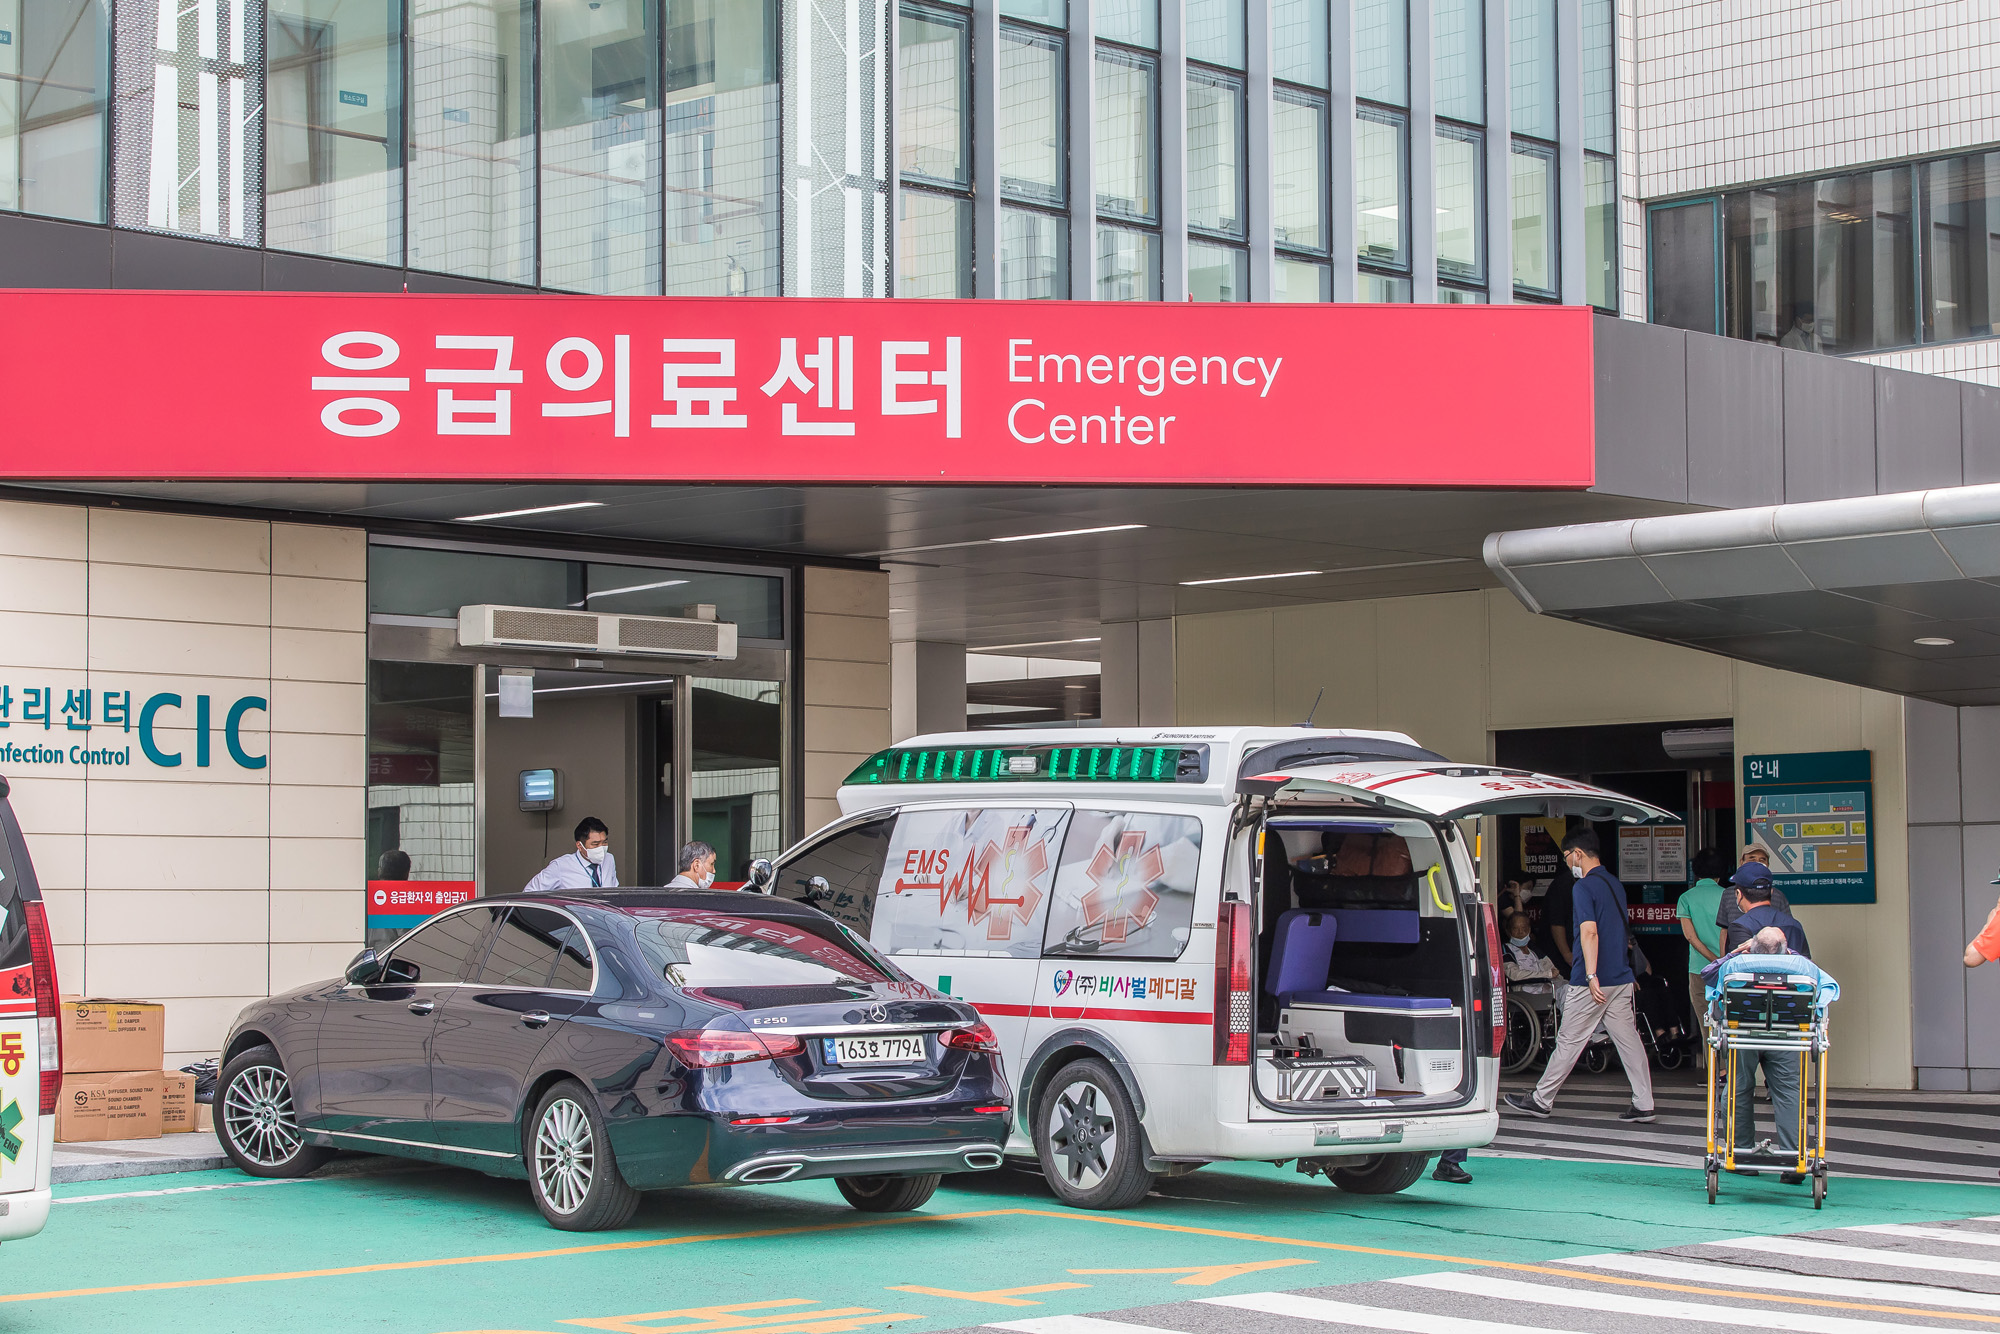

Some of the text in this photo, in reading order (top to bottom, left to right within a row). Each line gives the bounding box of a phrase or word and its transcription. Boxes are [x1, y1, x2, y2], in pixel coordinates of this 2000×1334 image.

[1009, 339, 1282, 398] Emergency
[312, 332, 961, 438] 응급의료센터
[1008, 399, 1175, 445] Center
[138, 693, 267, 769] CIC
[69, 745, 130, 766] Control
[1750, 760, 1779, 778] 안내
[903, 848, 949, 875] EMS
[391, 891, 424, 904] 응급환자
[435, 891, 468, 904] 출입금지
[1637, 908, 1645, 920] 외
[763, 1016, 788, 1024] 250
[882, 1038, 922, 1058] 7794
[90, 1090, 106, 1098] KSA
[3, 1138, 19, 1156] EMS
